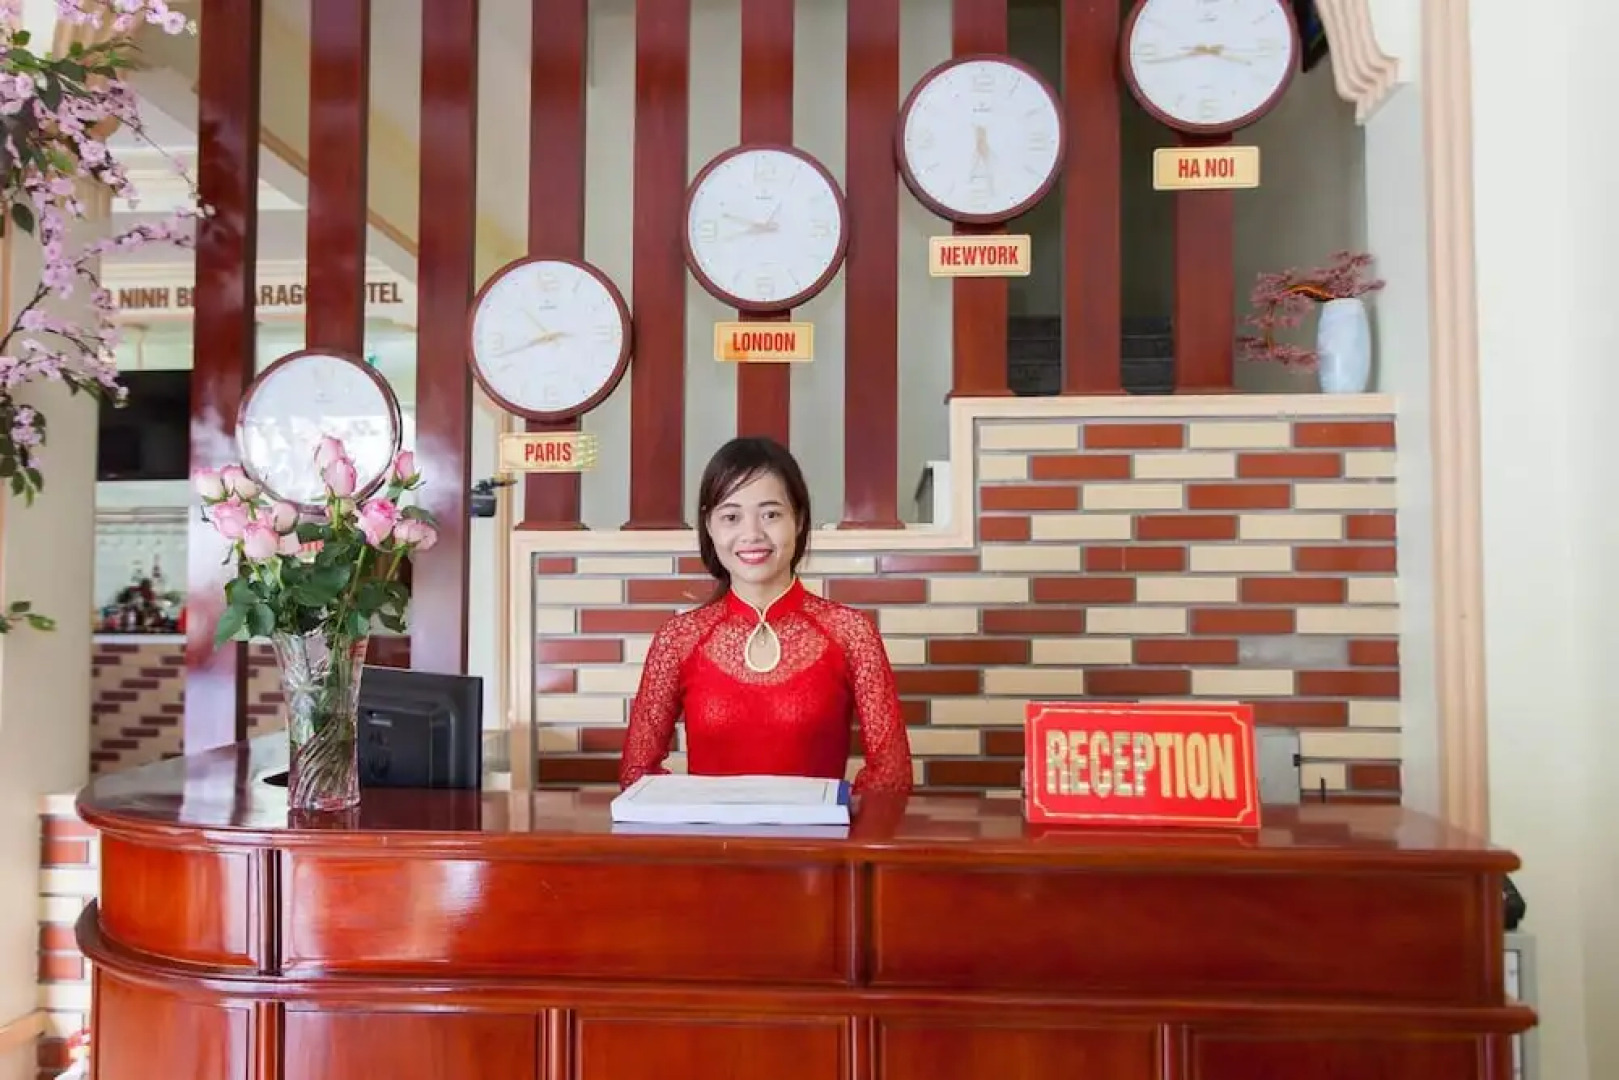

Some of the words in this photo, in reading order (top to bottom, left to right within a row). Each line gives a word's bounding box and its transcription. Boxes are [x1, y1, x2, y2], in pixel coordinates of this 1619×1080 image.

[1178, 158, 1200, 179] HA
[1204, 156, 1235, 178] NOI
[940, 245, 1019, 266] NEWYORK
[119, 287, 170, 309] NINH
[732, 332, 796, 352] LONDON
[524, 441, 572, 462] PARIS
[1045, 729, 1237, 800] RECEPTION
